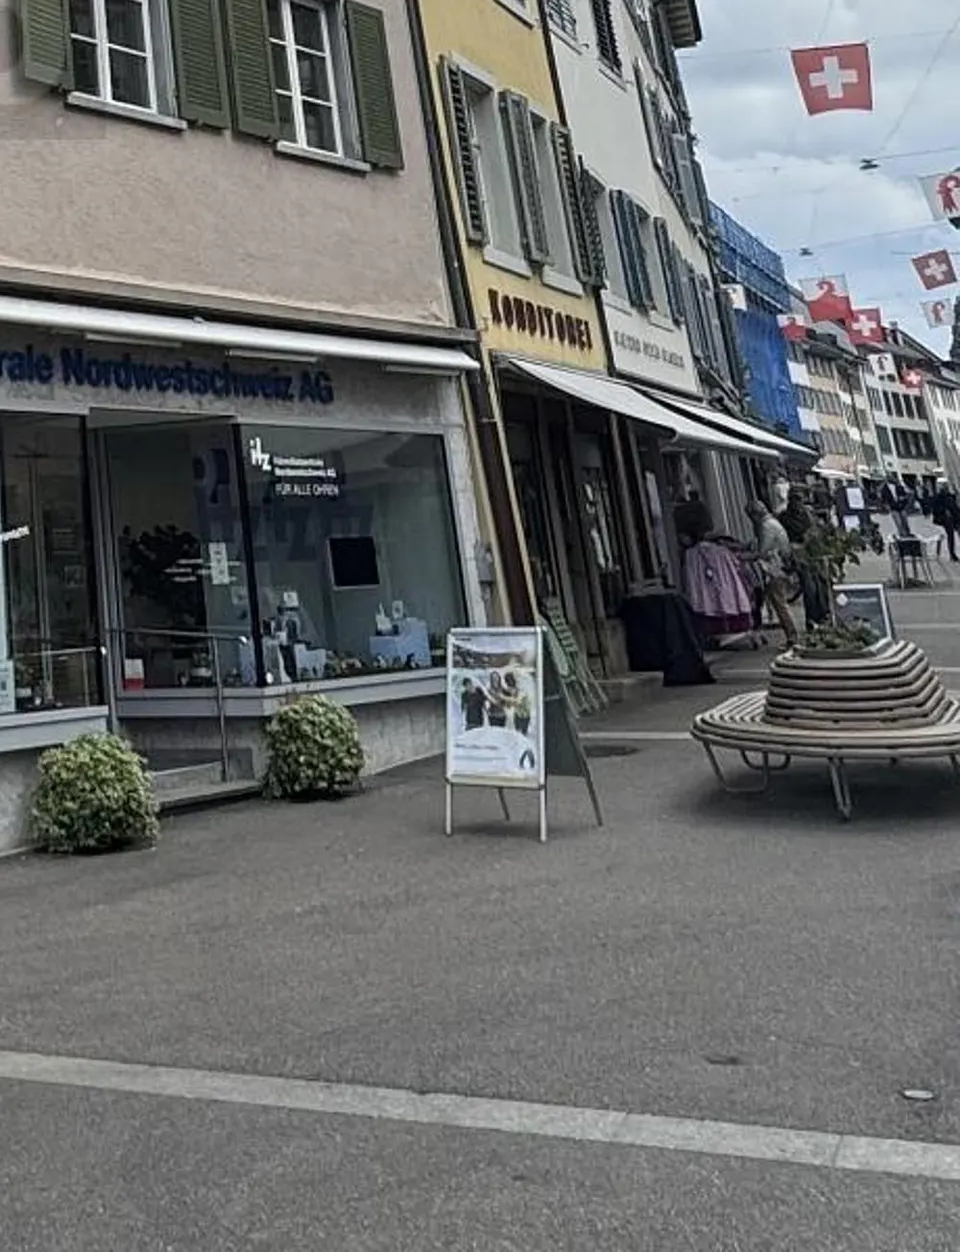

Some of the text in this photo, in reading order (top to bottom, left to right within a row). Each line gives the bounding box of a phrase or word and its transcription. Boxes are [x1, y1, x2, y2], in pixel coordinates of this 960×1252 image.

[488, 288, 593, 353] KONDITOREI
[60, 348, 294, 402] Nordwestschweiz
[297, 369, 335, 405] AG
